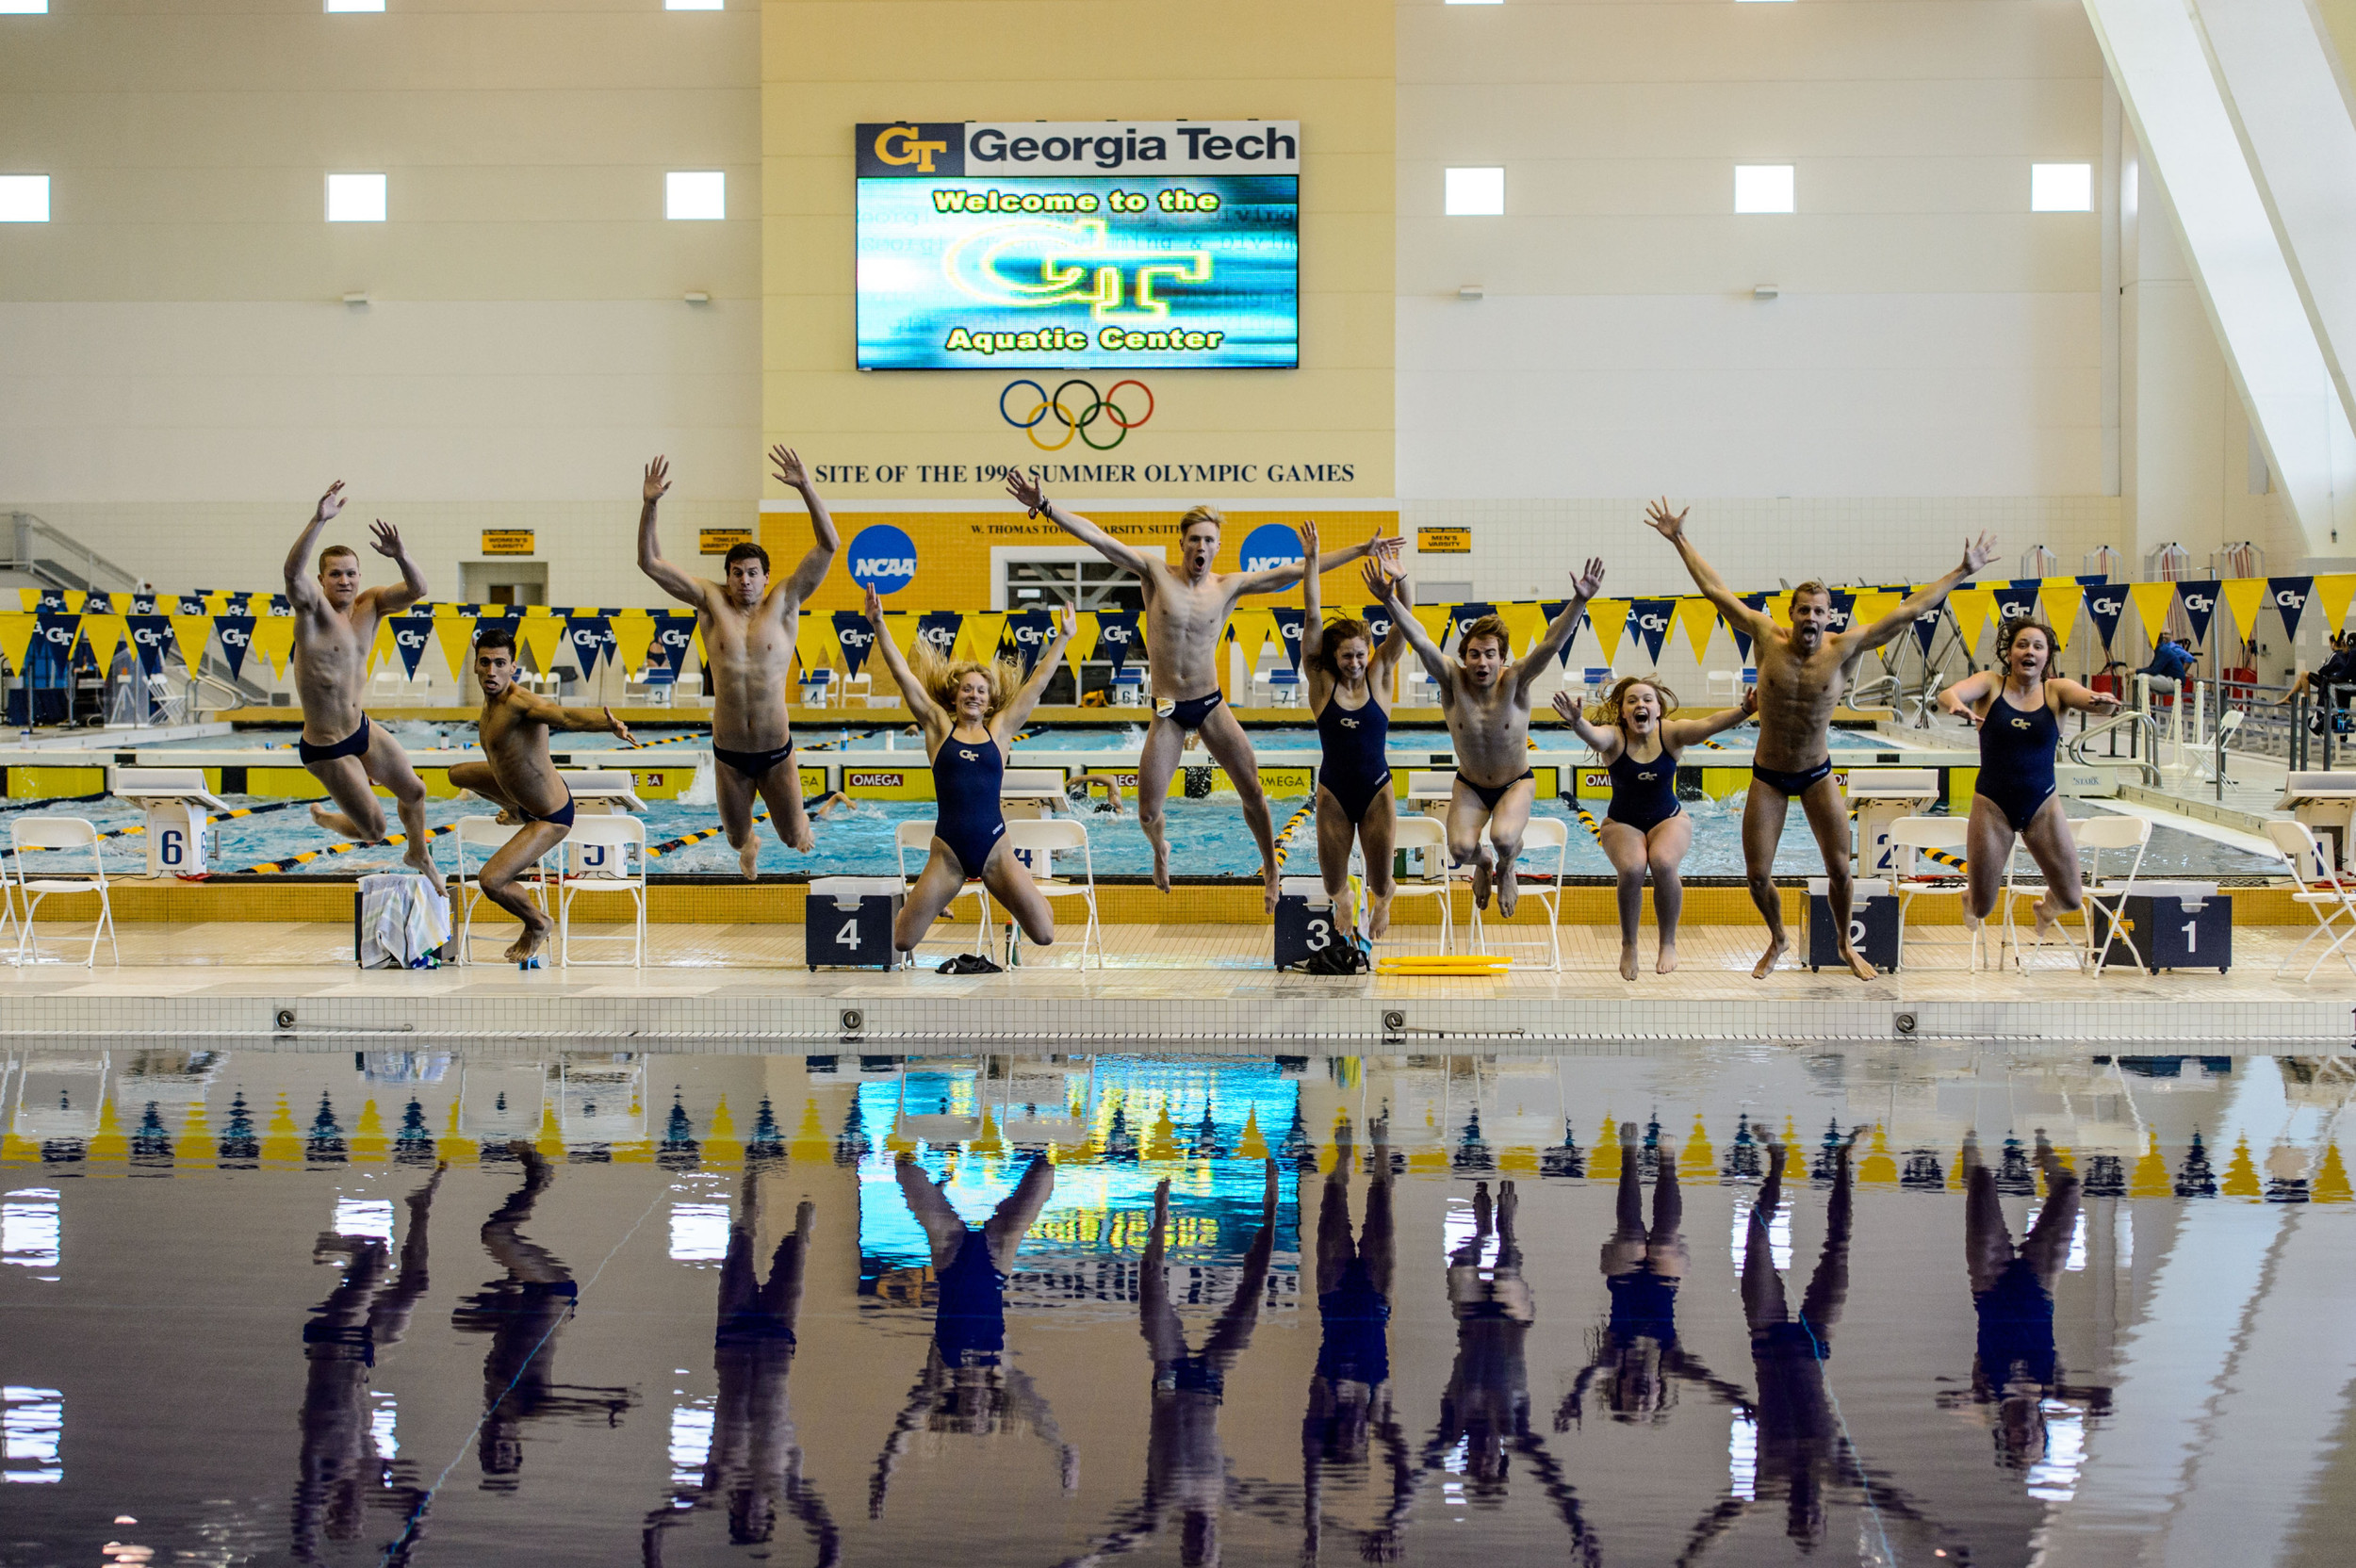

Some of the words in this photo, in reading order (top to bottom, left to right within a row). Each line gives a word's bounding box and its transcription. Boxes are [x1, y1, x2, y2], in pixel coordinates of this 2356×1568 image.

[875, 126, 946, 172] GT
[969, 127, 1167, 169] Georgia
[1176, 126, 1296, 161] Tech
[933, 189, 1100, 213] Welcome
[1108, 189, 1149, 213] to
[1157, 189, 1220, 213] the
[946, 327, 1088, 353] Aquatic
[1098, 326, 1224, 351] Center
[815, 465, 869, 483] SITE
[875, 465, 908, 483] OF
[917, 465, 968, 483] THE
[1028, 464, 1137, 483] SUMMER
[1144, 465, 1257, 483] OLYMPIC
[1268, 465, 1354, 482] GAMES
[971, 525, 985, 534] W.
[989, 525, 1039, 534] THOMAS
[855, 558, 915, 577] NCAA
[2092, 597, 2121, 615] GT
[2184, 594, 2214, 612] GT
[2276, 590, 2305, 609] GT
[1639, 613, 1668, 632] GT
[46, 627, 74, 646] GT
[134, 628, 162, 647] GT
[221, 629, 250, 647] GT
[396, 629, 425, 648] GT
[573, 629, 602, 648] GT
[662, 629, 690, 648] GT
[839, 629, 868, 647] GT
[927, 627, 956, 645] GT
[1015, 626, 1043, 645] GT
[1104, 625, 1132, 645] GT
[852, 774, 902, 787] OMEGA
[161, 829, 183, 865] 6
[1877, 834, 1899, 869] 2
[836, 919, 861, 951] 4
[1306, 919, 1332, 952] 3
[1848, 920, 1867, 953] 2
[2181, 920, 2196, 953] 1
